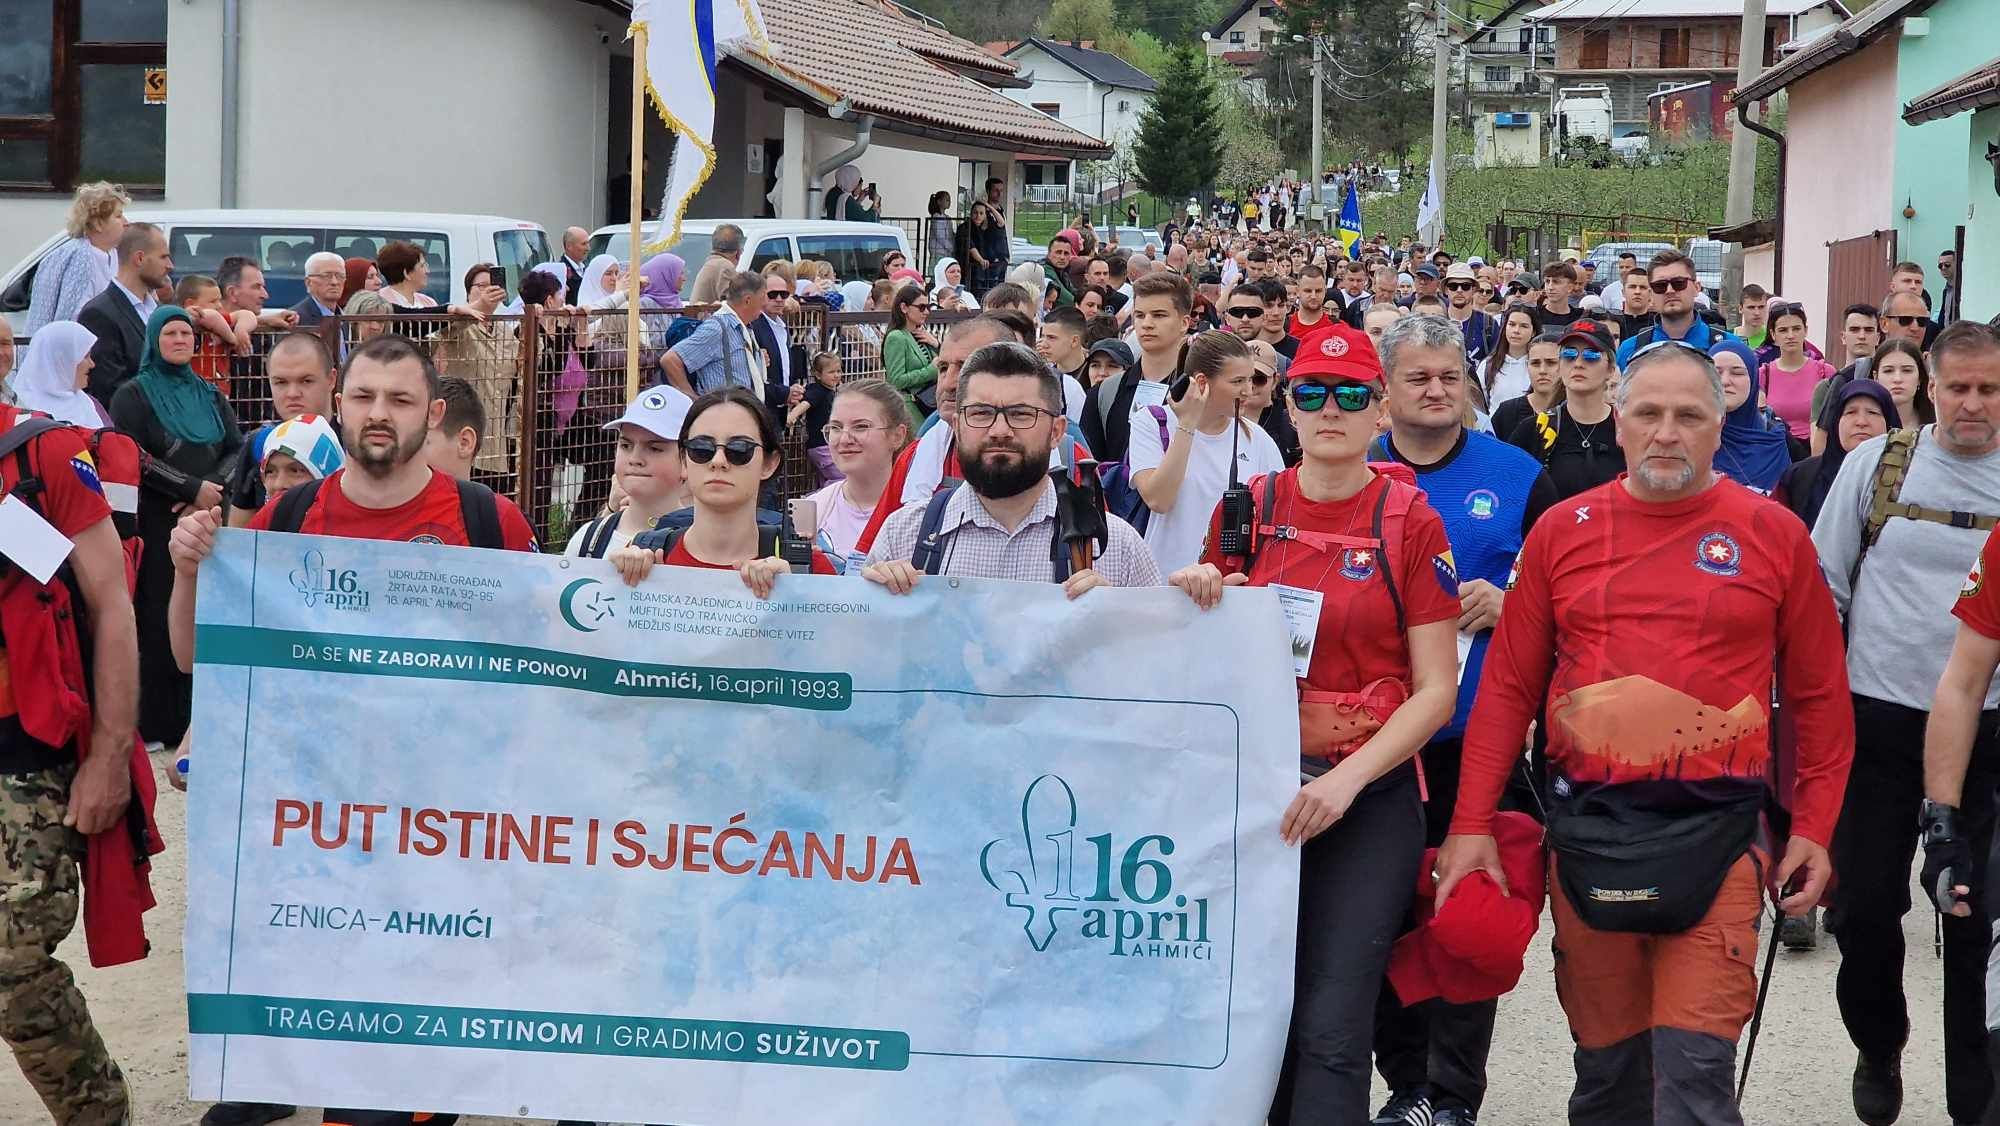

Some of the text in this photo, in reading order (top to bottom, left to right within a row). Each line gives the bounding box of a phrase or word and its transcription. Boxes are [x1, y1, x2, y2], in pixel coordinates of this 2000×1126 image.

[388, 569, 502, 588] UDRUŽENJE GRAĐANA
[388, 581, 428, 594] ŽRTAVA
[431, 585, 457, 597] RATA
[324, 591, 370, 610] april
[630, 591, 681, 605] ISLAMSKA
[684, 596, 743, 610] ZAJEDNICA
[745, 600, 752, 610] U
[755, 601, 788, 613] BOSNI
[797, 603, 870, 614] HERCEGOVINI
[629, 605, 758, 625] MUFTIJSTVO TRAVNIČKO
[628, 619, 815, 641] MEDŽLIS ISLAMSKE ZAJEDNICE VITEZ
[292, 644, 844, 700] DA SE NE ZABORAVI I NE PONOVI Ahmići, 16.april 1993.
[272, 799, 922, 886] PUT ISTINE I SJEĆANJA
[269, 903, 494, 939] ZENICA-AHMIĆI
[1081, 894, 1212, 956] april
[1131, 942, 1212, 961] AHMIĆI
[265, 1006, 881, 1061] TRAGAMO ZA ISTINOM I GRADIMO SUŽIVOT
